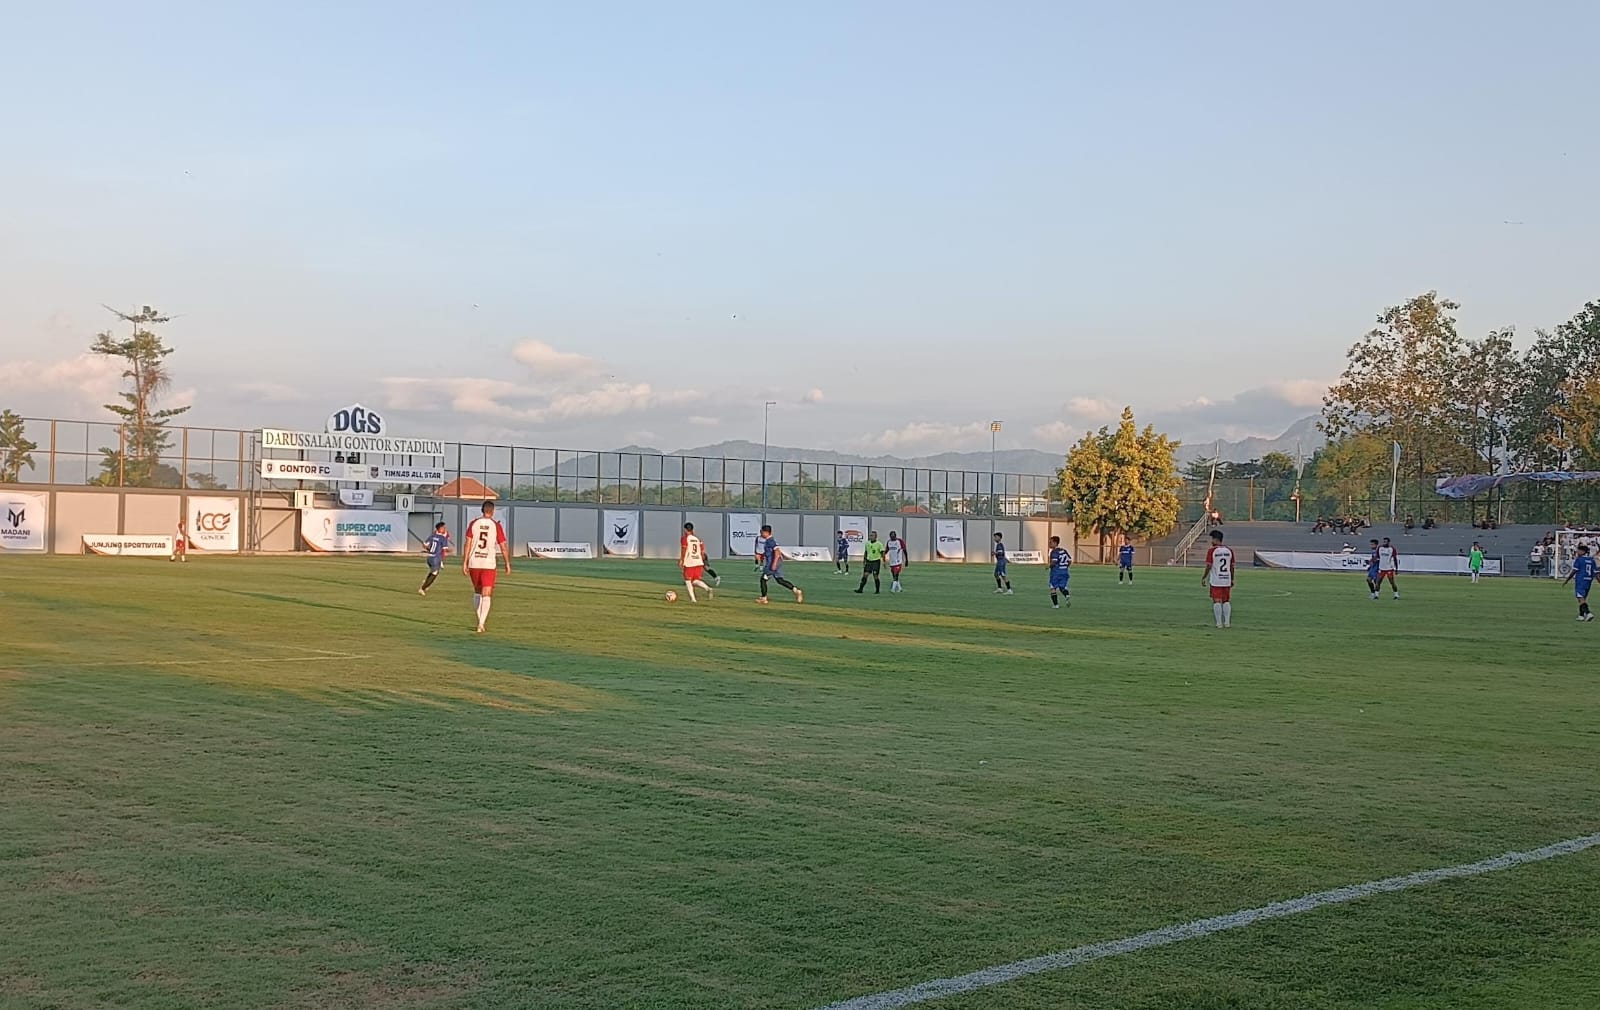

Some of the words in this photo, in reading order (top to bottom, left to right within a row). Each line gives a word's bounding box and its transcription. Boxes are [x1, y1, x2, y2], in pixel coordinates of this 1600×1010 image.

[333, 407, 381, 434] DGS
[265, 432, 342, 449] DARUSSALAM
[344, 436, 391, 452] GONTOR
[394, 440, 442, 455] STADIUM
[279, 464, 317, 474] GONTOR
[318, 466, 331, 474] FC
[384, 469, 410, 478] TIMNAS
[424, 471, 441, 479] STAR
[402, 497, 409, 509] 0
[336, 523, 366, 532] SUPER
[367, 523, 392, 532] COPA
[478, 531, 488, 549] 5
[1219, 558, 1228, 572] 2
